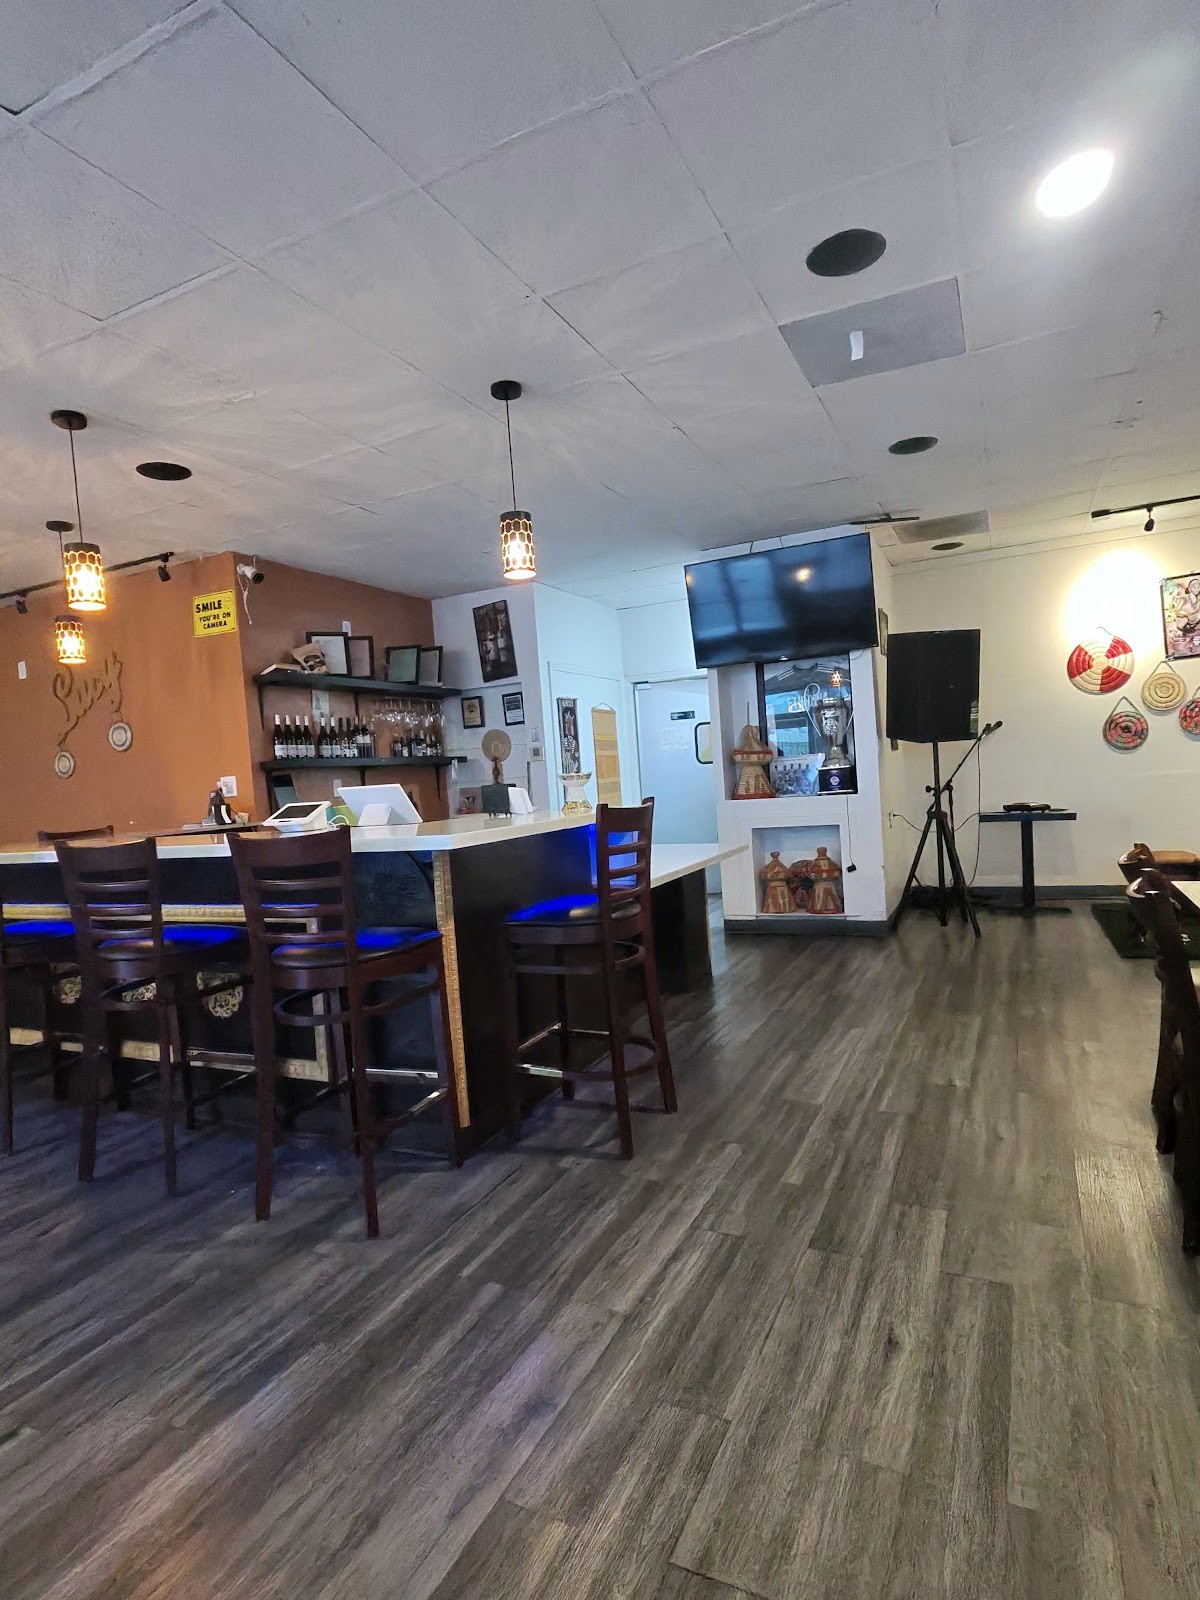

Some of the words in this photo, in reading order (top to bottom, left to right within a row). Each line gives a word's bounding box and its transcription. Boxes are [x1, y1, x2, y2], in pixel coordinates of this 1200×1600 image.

[195, 600, 222, 613] SMILE
[199, 614, 220, 622] YOU'RE
[203, 621, 227, 629] CAMERA
